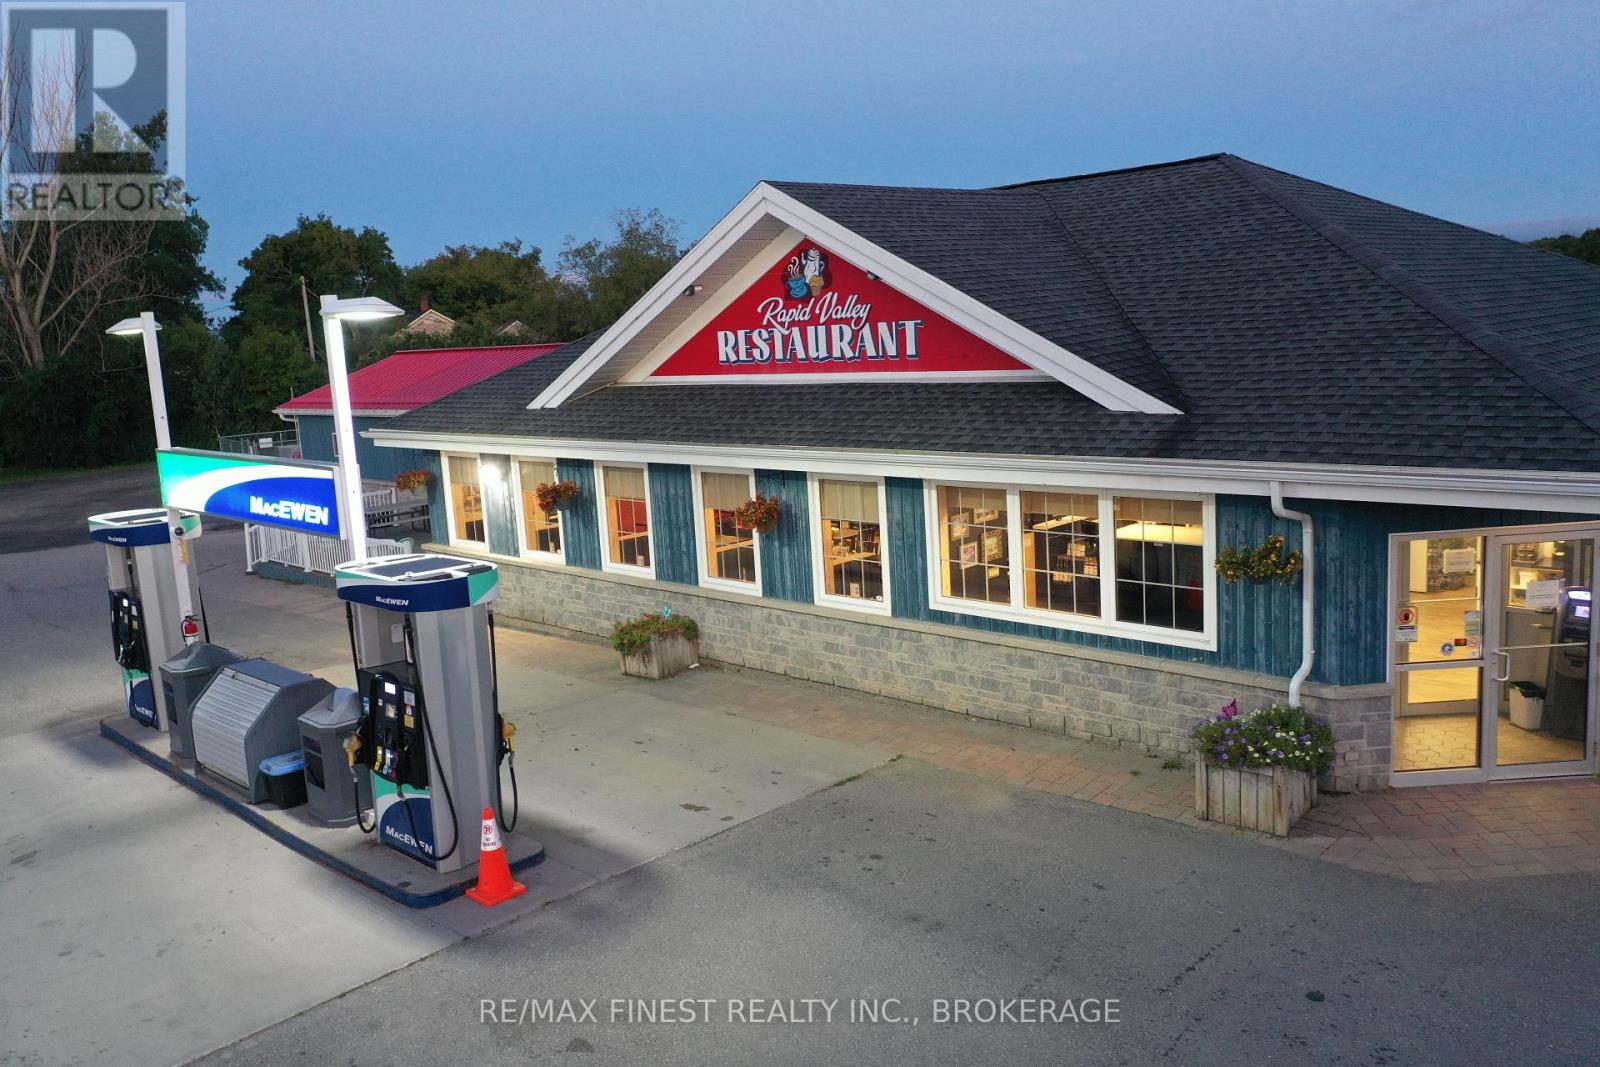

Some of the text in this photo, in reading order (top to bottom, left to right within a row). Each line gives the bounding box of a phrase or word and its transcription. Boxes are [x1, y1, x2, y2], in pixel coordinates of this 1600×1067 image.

[757, 291, 872, 335] Rapid Valley
[716, 319, 924, 365] RESTAURANT
